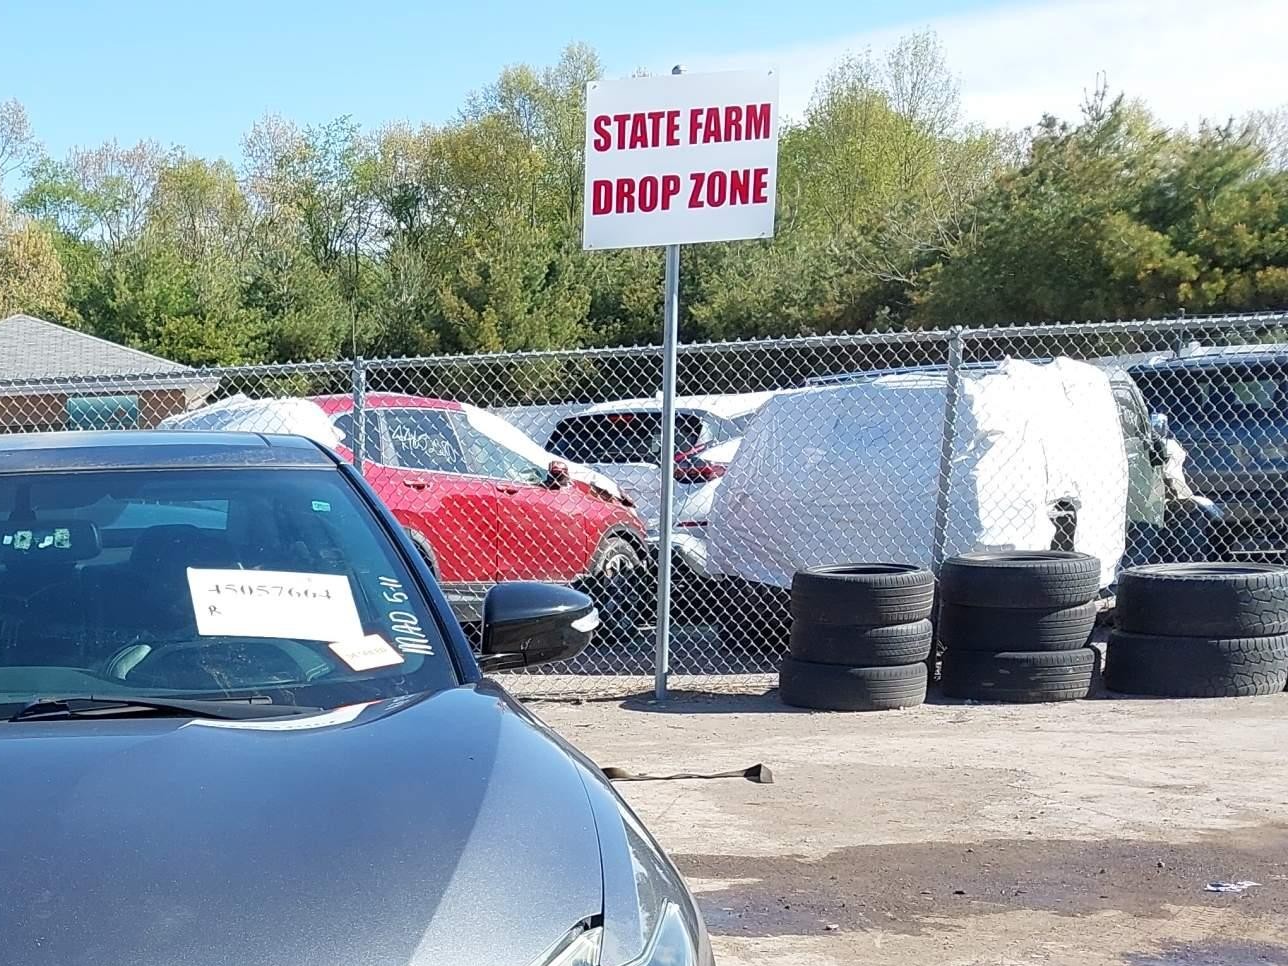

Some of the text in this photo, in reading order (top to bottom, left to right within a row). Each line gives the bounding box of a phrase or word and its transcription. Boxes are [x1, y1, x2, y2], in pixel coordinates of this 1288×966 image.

[593, 102, 772, 153] STATE FARM
[591, 167, 769, 216] DROP ZONE
